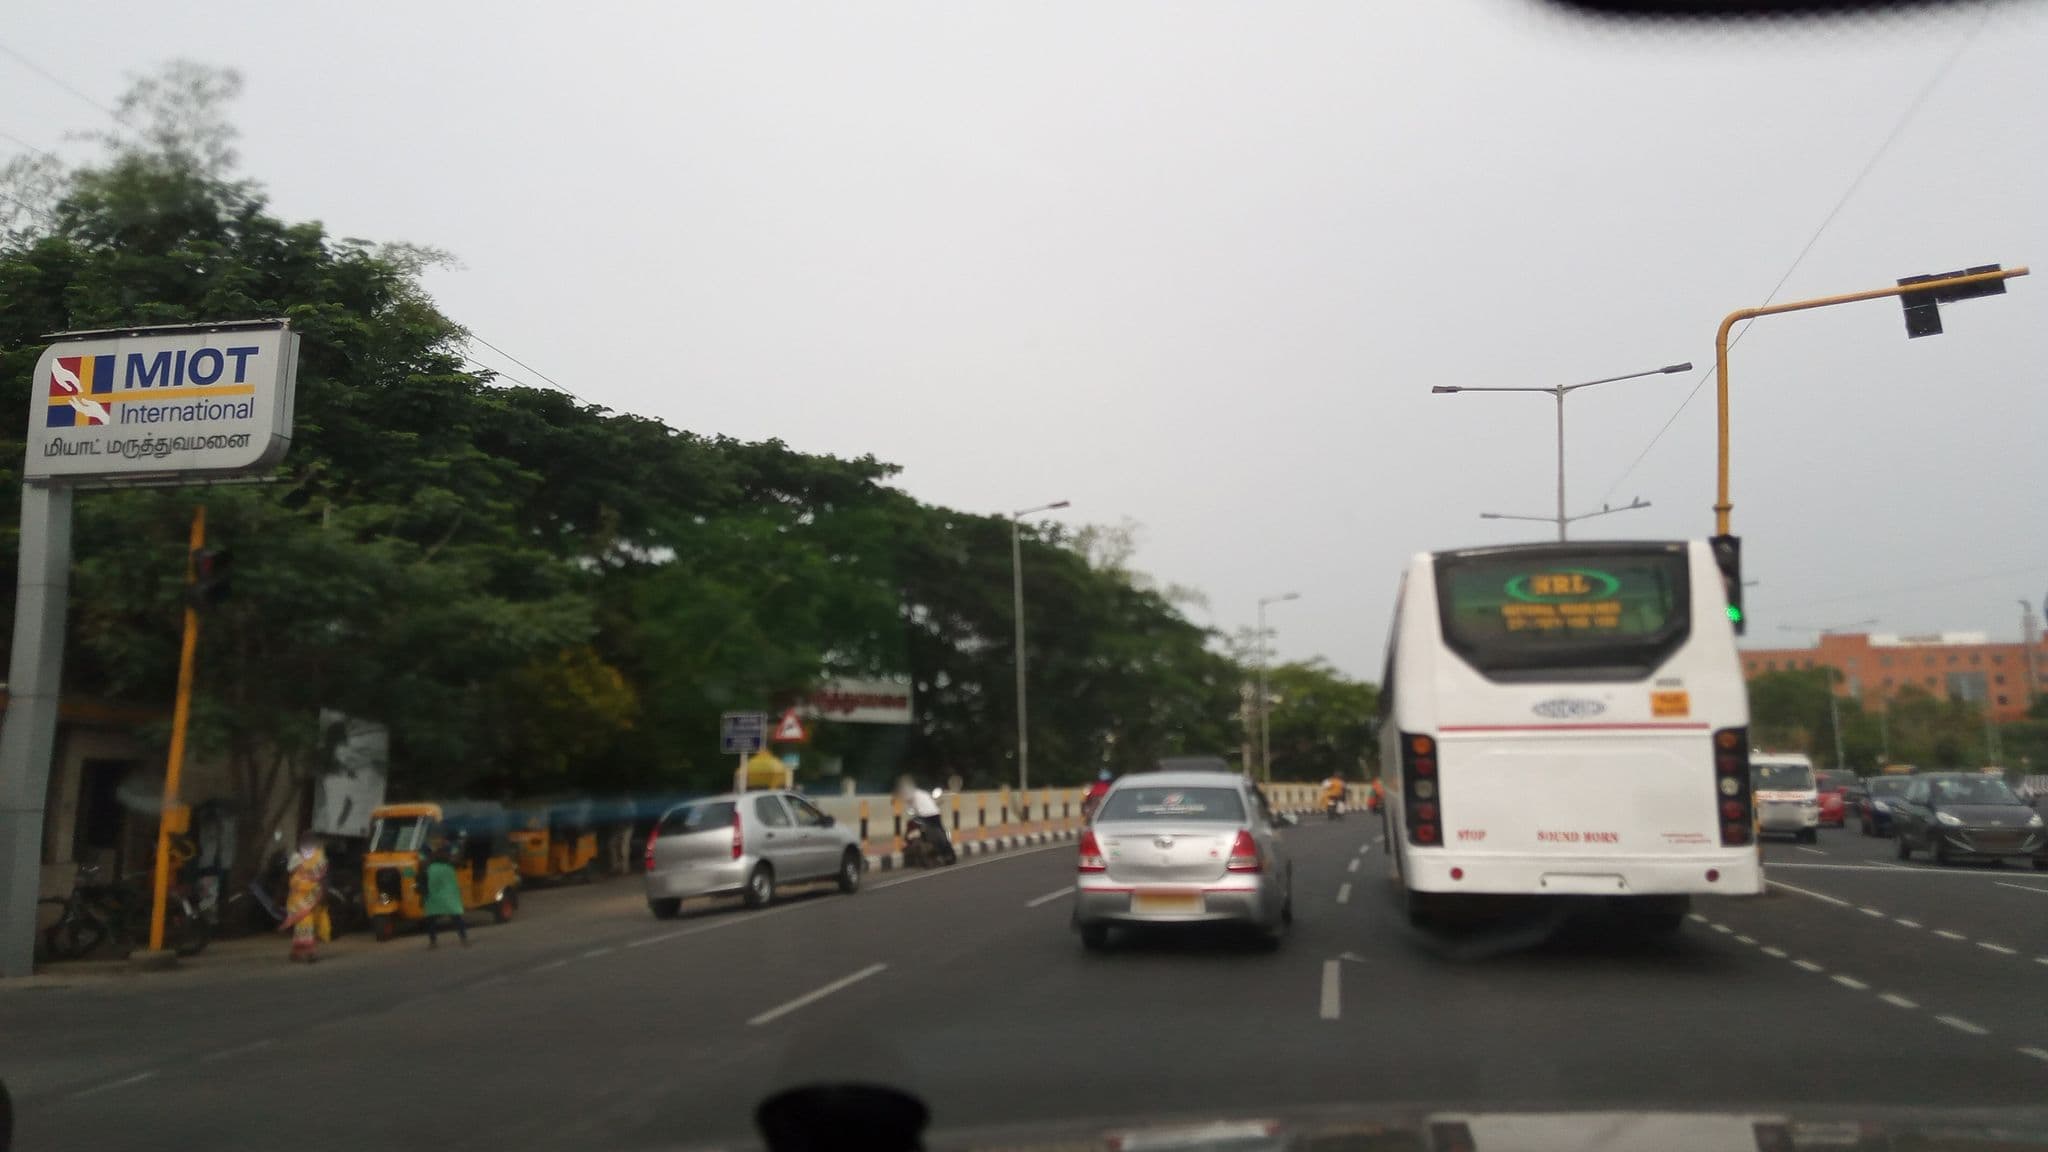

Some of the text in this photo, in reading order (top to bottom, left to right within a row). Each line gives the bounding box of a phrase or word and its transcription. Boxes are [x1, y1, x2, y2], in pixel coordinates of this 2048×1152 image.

[125, 346, 259, 389] MIOT
[121, 397, 254, 424] International
[44, 432, 251, 459] மியாட் மருத்துவமனை
[1457, 829, 1487, 841] STOP
[1537, 830, 1619, 844] SOUND HORN
